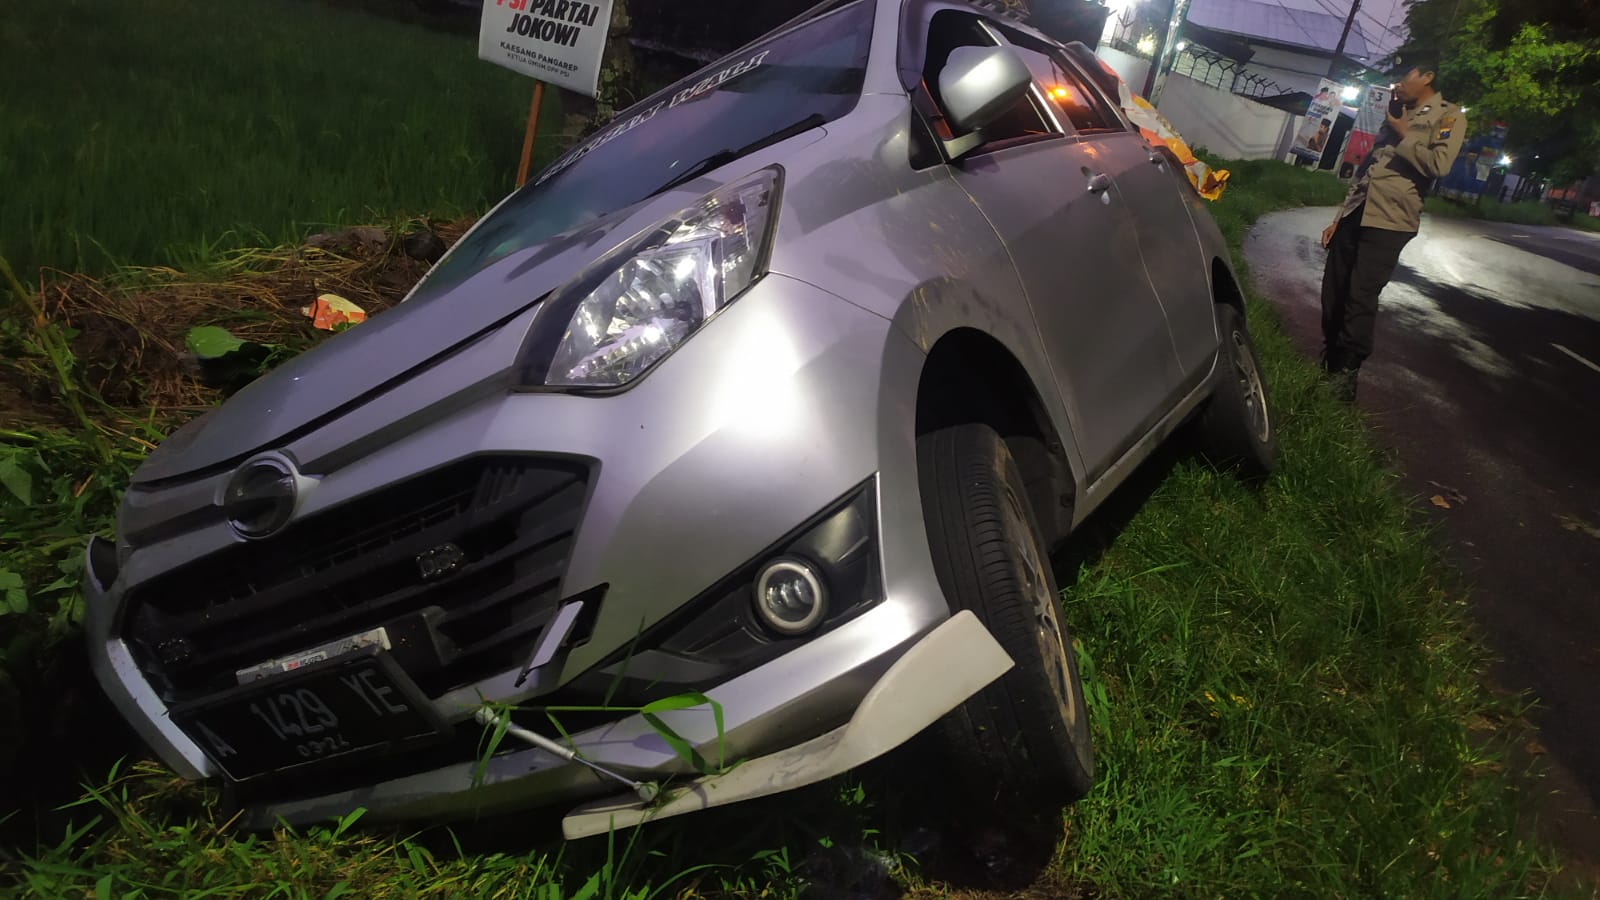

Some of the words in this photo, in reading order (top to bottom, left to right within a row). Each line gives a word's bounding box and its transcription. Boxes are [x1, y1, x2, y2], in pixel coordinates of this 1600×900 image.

[530, 0, 599, 27] PARTAI
[507, 13, 581, 47] JOKOWI
[500, 41, 537, 59] KAESANG
[538, 53, 578, 72] PANGAREP
[1375, 91, 1384, 102] 3
[195, 720, 238, 758] A
[250, 688, 338, 740] 1429
[339, 668, 408, 717] YE
